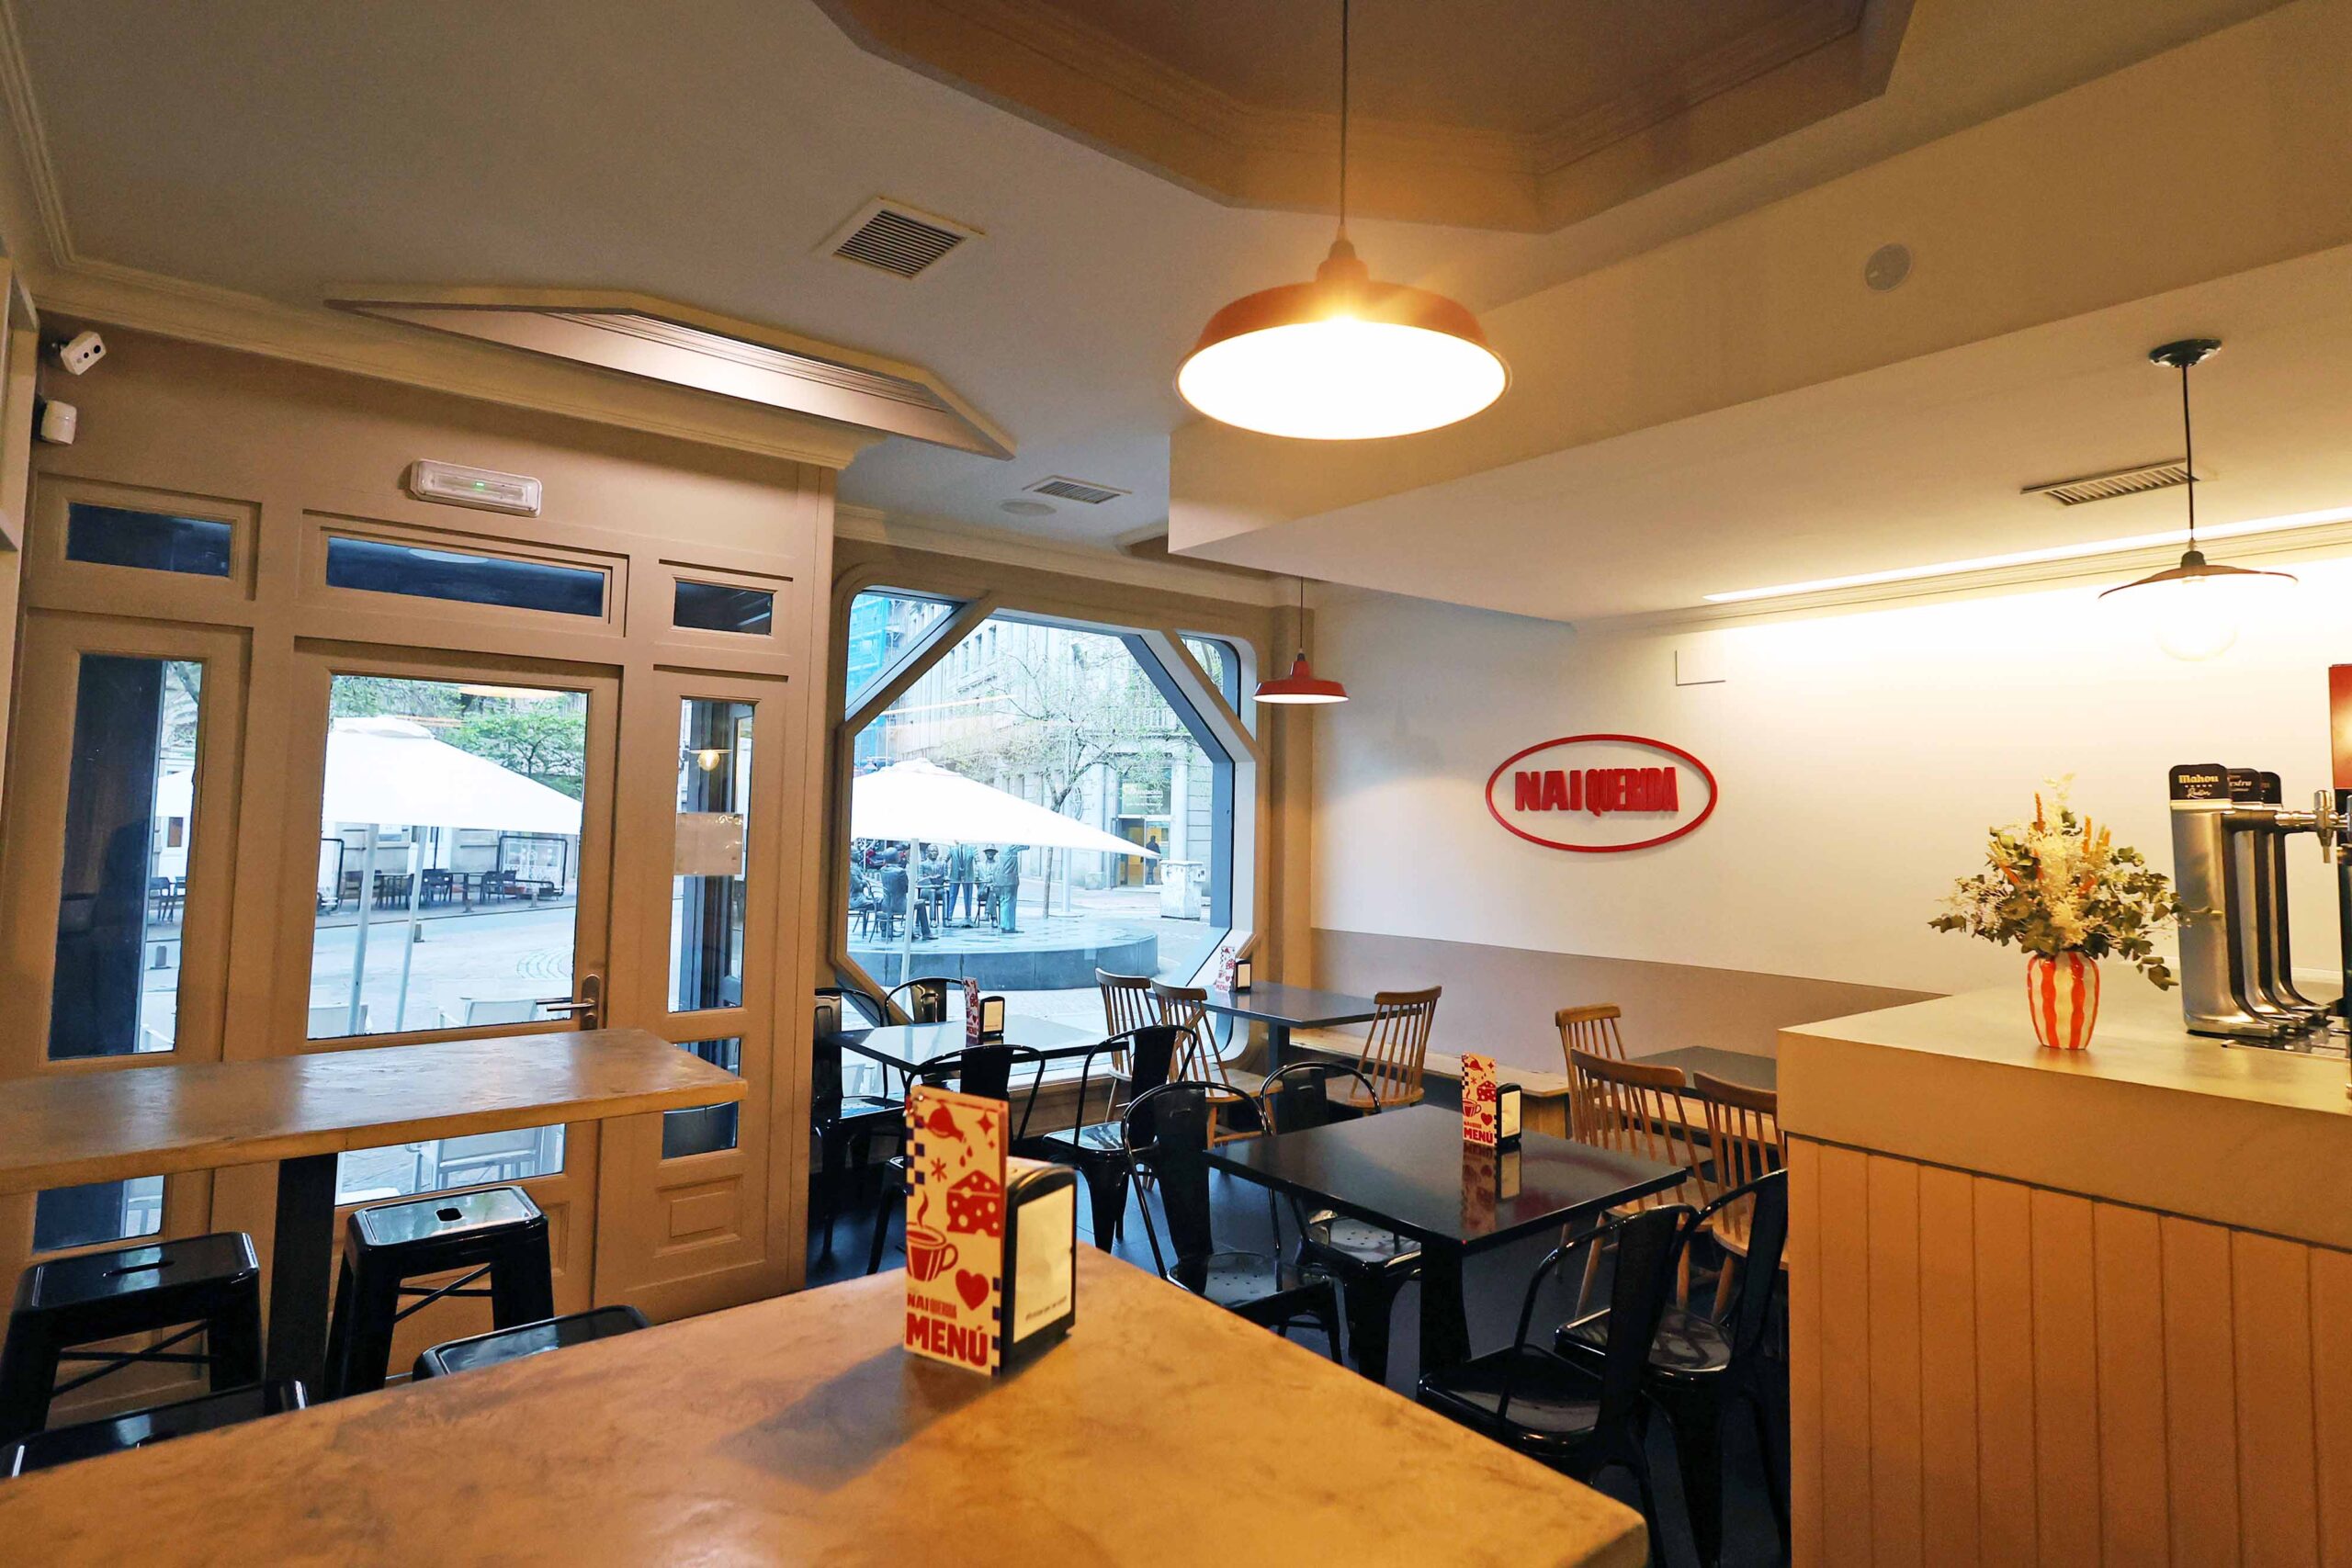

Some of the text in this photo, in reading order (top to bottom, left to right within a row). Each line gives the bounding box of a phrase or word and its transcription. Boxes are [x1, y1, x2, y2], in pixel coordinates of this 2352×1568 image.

[1515, 767, 1679, 817] NAI QUERIDA
[2178, 774, 2219, 784] Mahou
[906, 1312, 988, 1367] MENÚ
